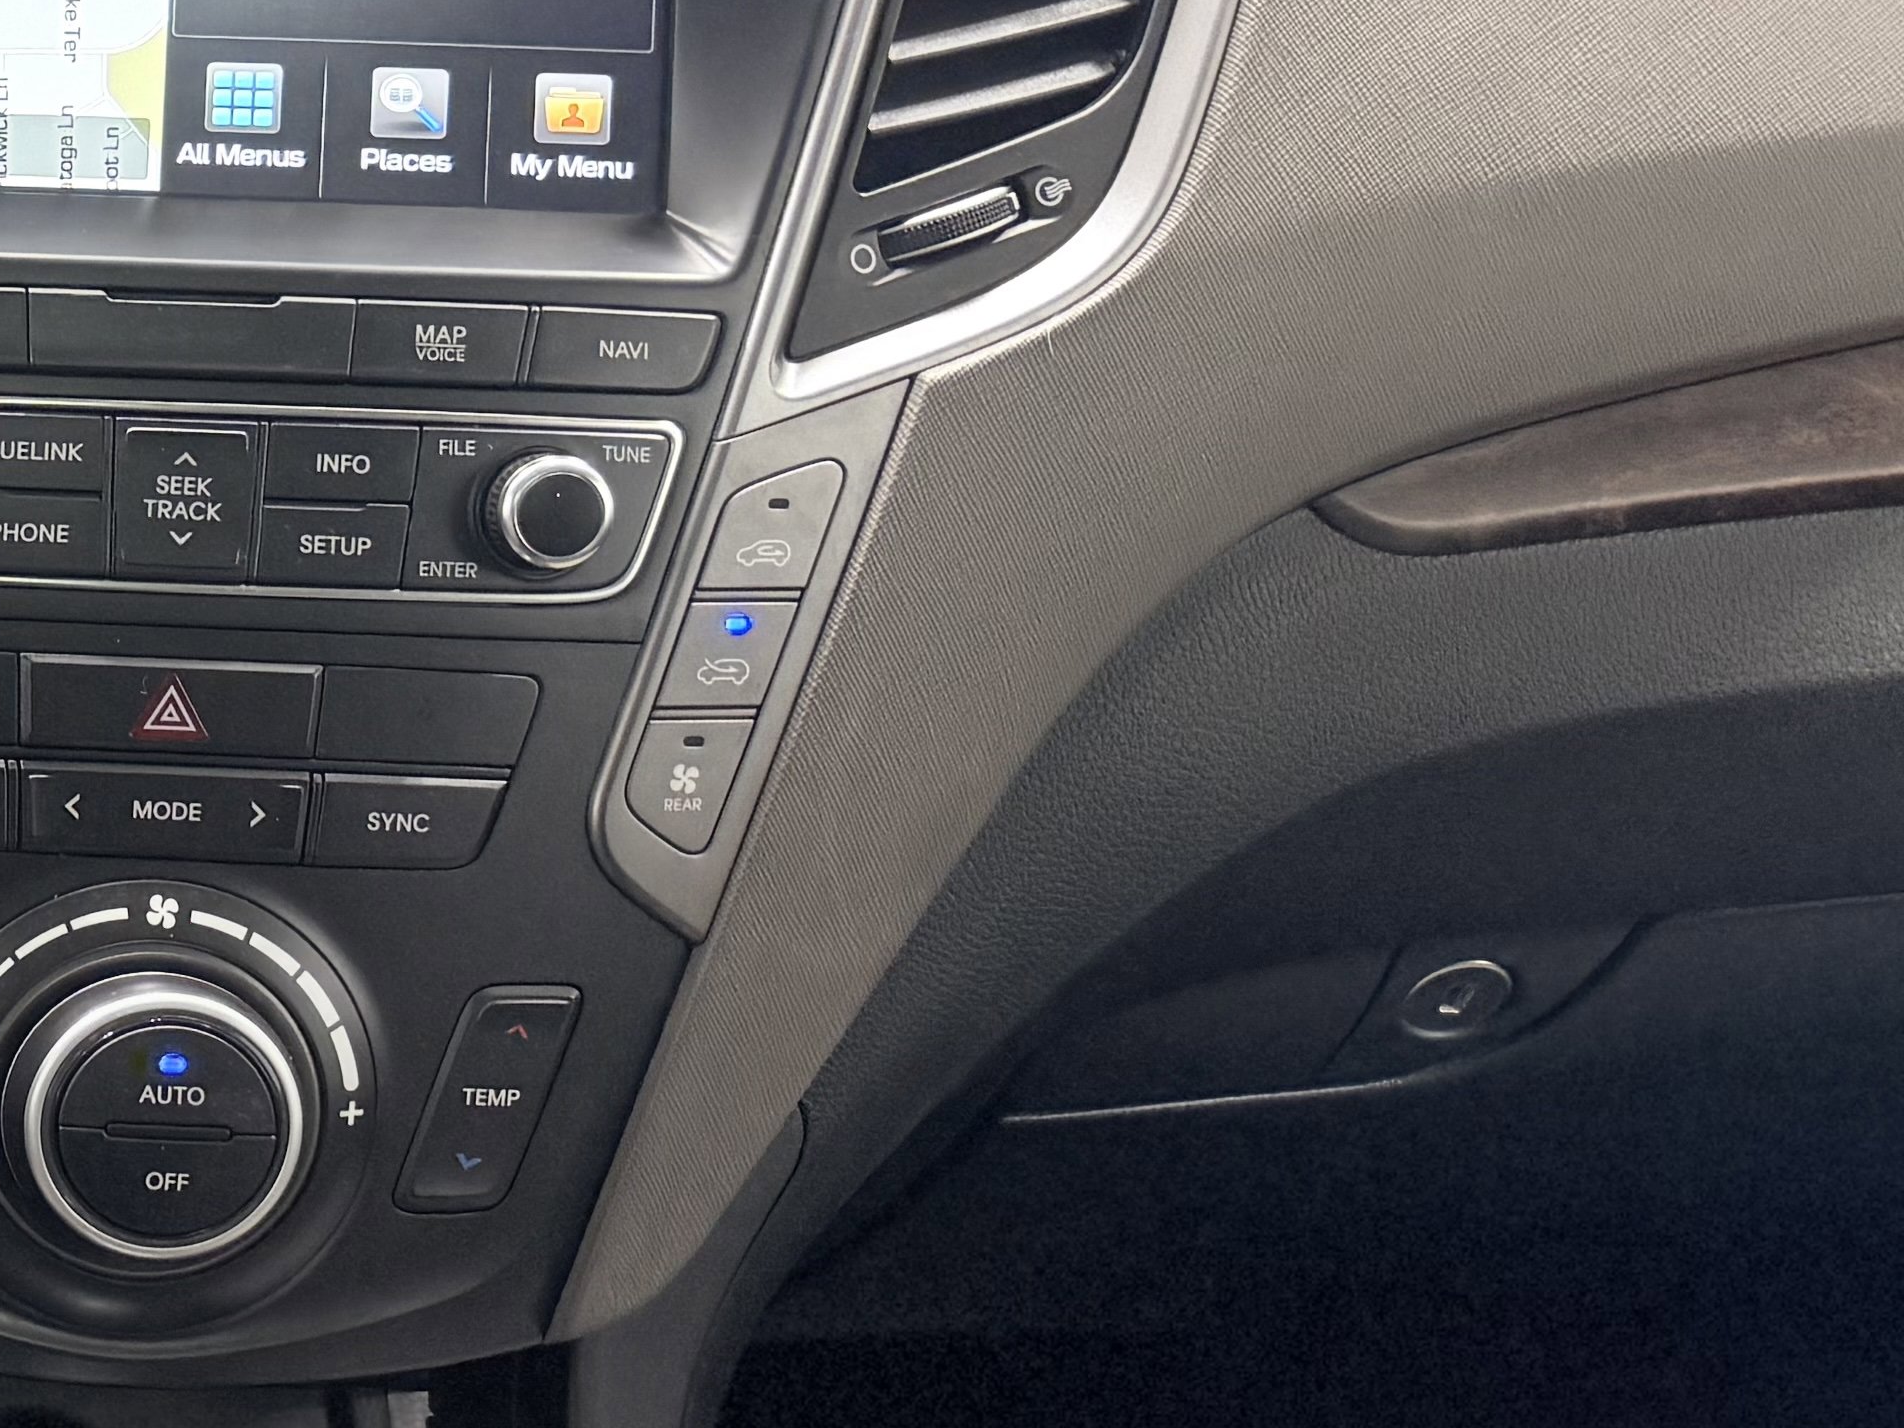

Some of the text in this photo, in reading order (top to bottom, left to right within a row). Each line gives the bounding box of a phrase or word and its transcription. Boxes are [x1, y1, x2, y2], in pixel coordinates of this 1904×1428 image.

[64, 27, 80, 62] Ter
[57, 105, 74, 129] Ln
[103, 127, 119, 151] Ln
[177, 142, 306, 169] All Menus
[361, 149, 453, 174] Places
[511, 154, 634, 181] My Menu
[415, 324, 466, 345] MAP
[416, 347, 466, 363] VOICE
[599, 341, 649, 360] NAVI
[438, 439, 476, 456] FILE
[602, 445, 650, 464] TUNE
[316, 453, 371, 474] INFO
[156, 475, 212, 497] SEEK
[143, 499, 222, 522] TRACK
[299, 534, 372, 556] SETUP
[419, 561, 478, 579] ENTER
[133, 801, 202, 822] MODE
[664, 798, 702, 813] REAR
[367, 812, 430, 834] SYNC
[139, 1085, 205, 1107] AUTO
[462, 1086, 521, 1108] TEMP
[144, 1171, 189, 1193] OFF
